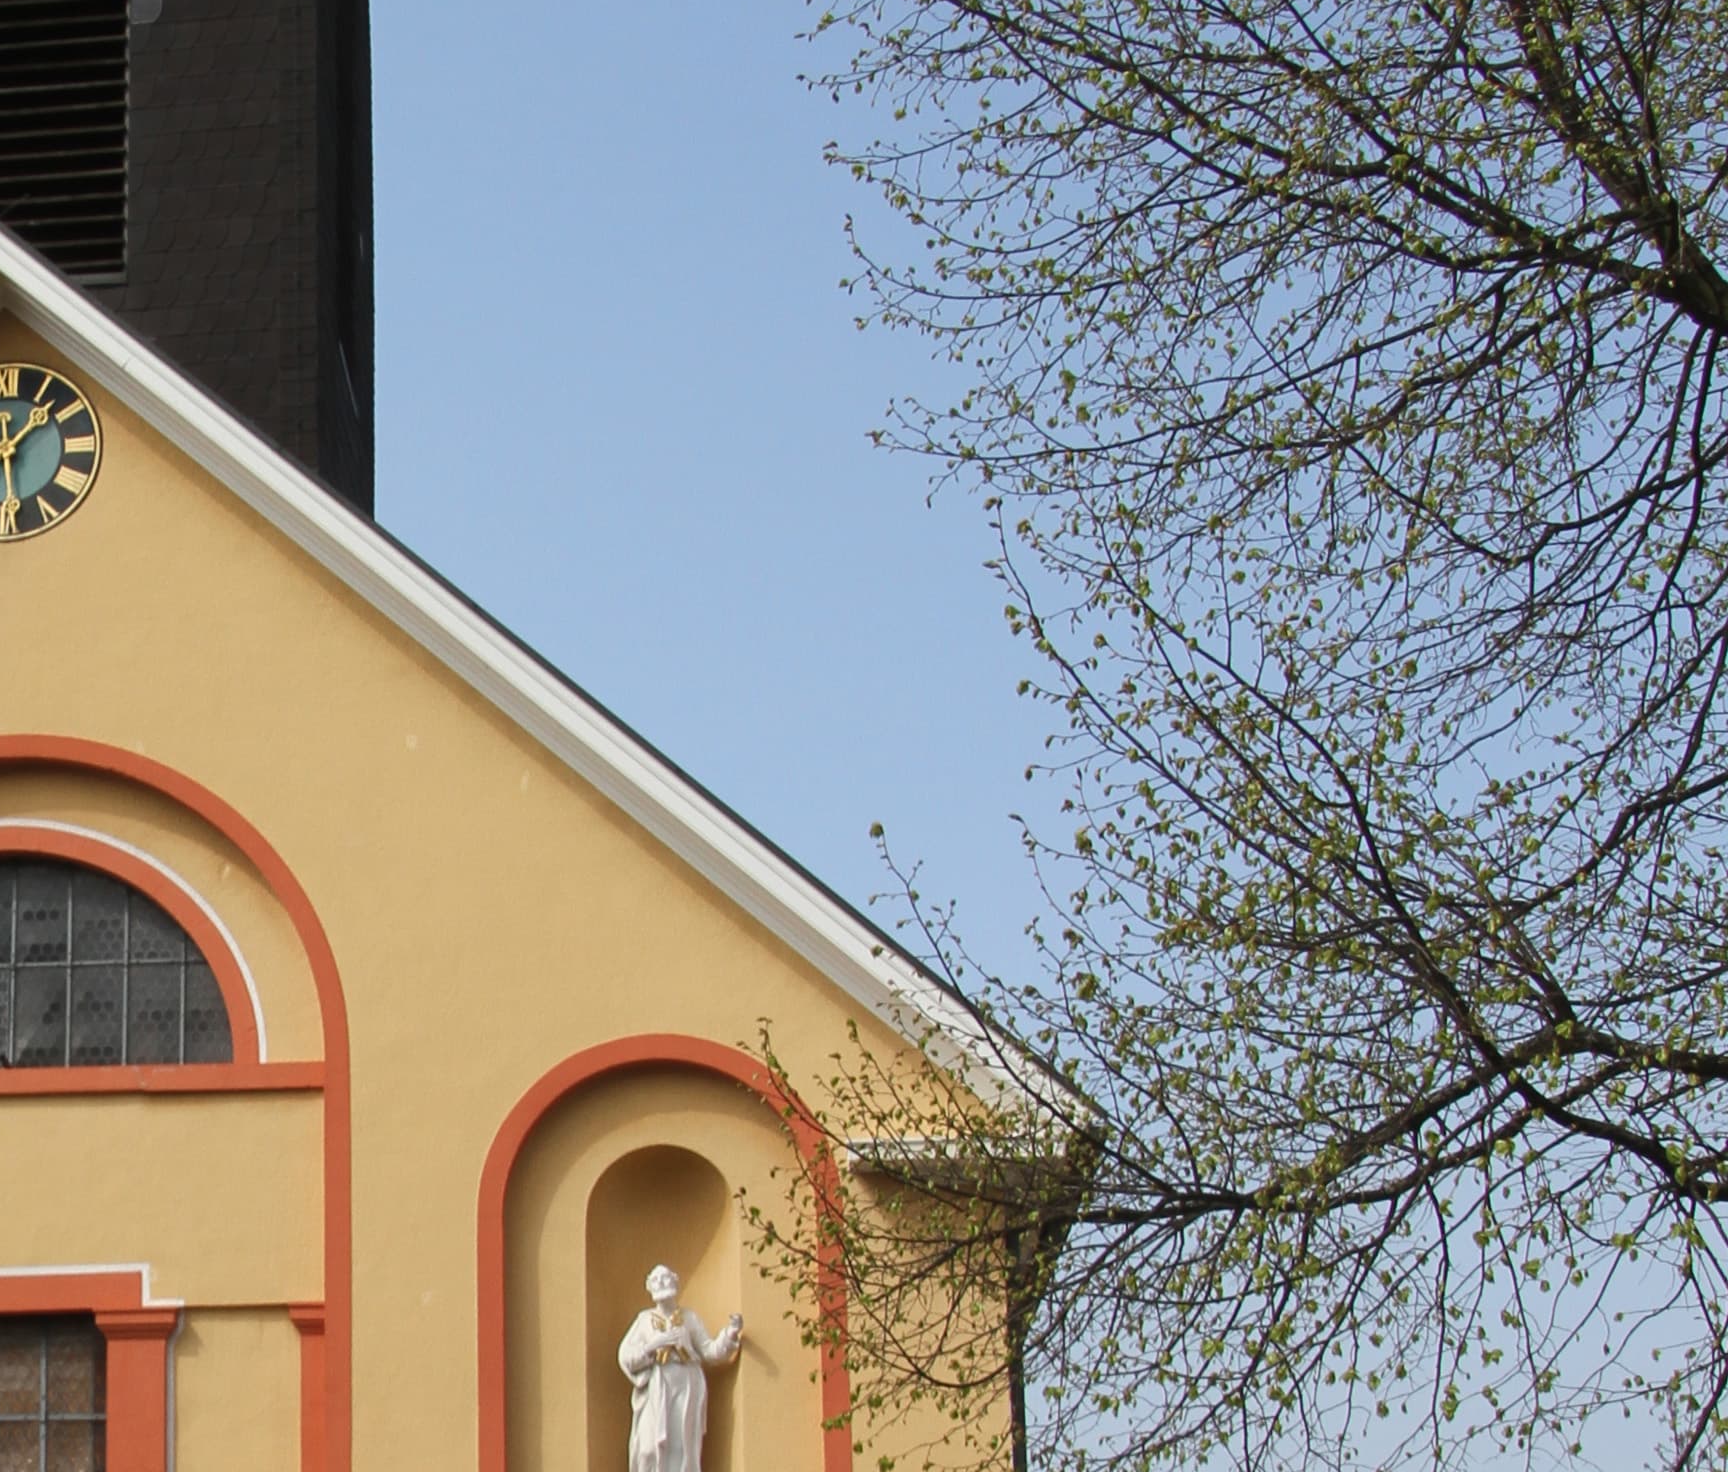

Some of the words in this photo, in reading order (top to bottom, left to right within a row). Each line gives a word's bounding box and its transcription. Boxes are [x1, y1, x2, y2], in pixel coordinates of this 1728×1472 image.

[33, 375, 52, 402] I
[55, 399, 85, 422] II
[64, 435, 94, 453] III
[54, 466, 89, 494] IIII
[36, 496, 59, 523] V
